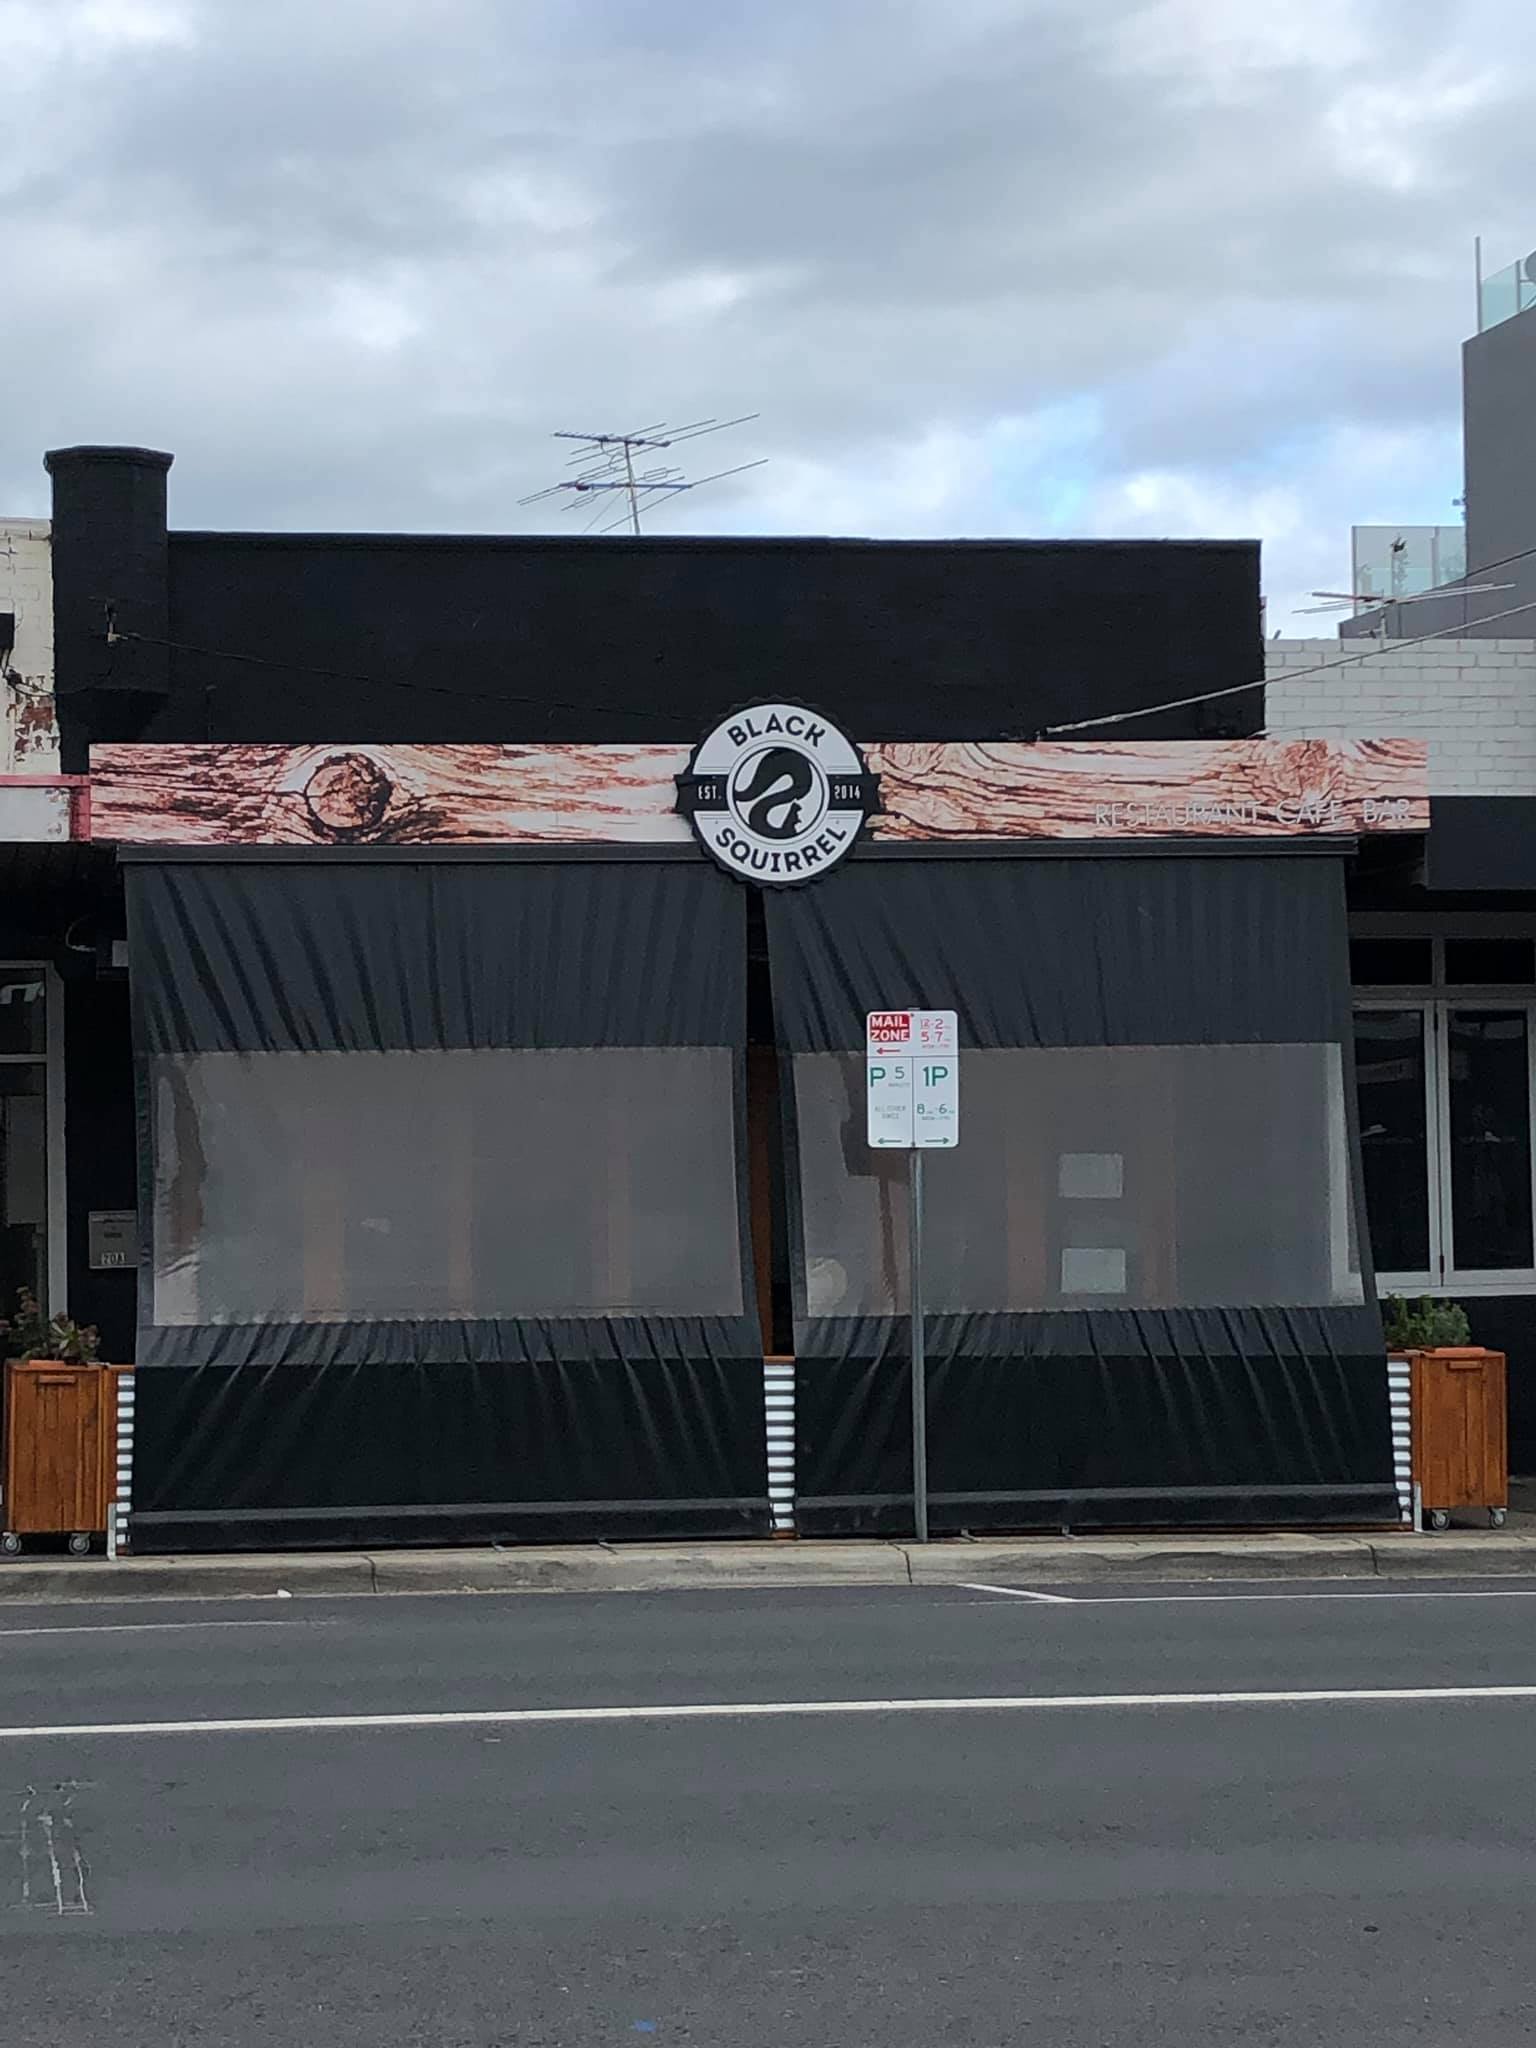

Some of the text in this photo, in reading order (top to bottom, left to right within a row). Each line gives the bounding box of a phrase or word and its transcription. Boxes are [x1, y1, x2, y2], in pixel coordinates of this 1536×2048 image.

[727, 713, 825, 747] BLACK
[1095, 800, 1257, 826] RESTAURANT
[1363, 798, 1410, 823] BAR
[715, 828, 847, 872] SQUIRREL
[871, 1016, 908, 1027] MAIL
[871, 1030, 909, 1041] ZONE
[870, 1066, 904, 1087] P 5
[922, 1066, 948, 1087] 1P
